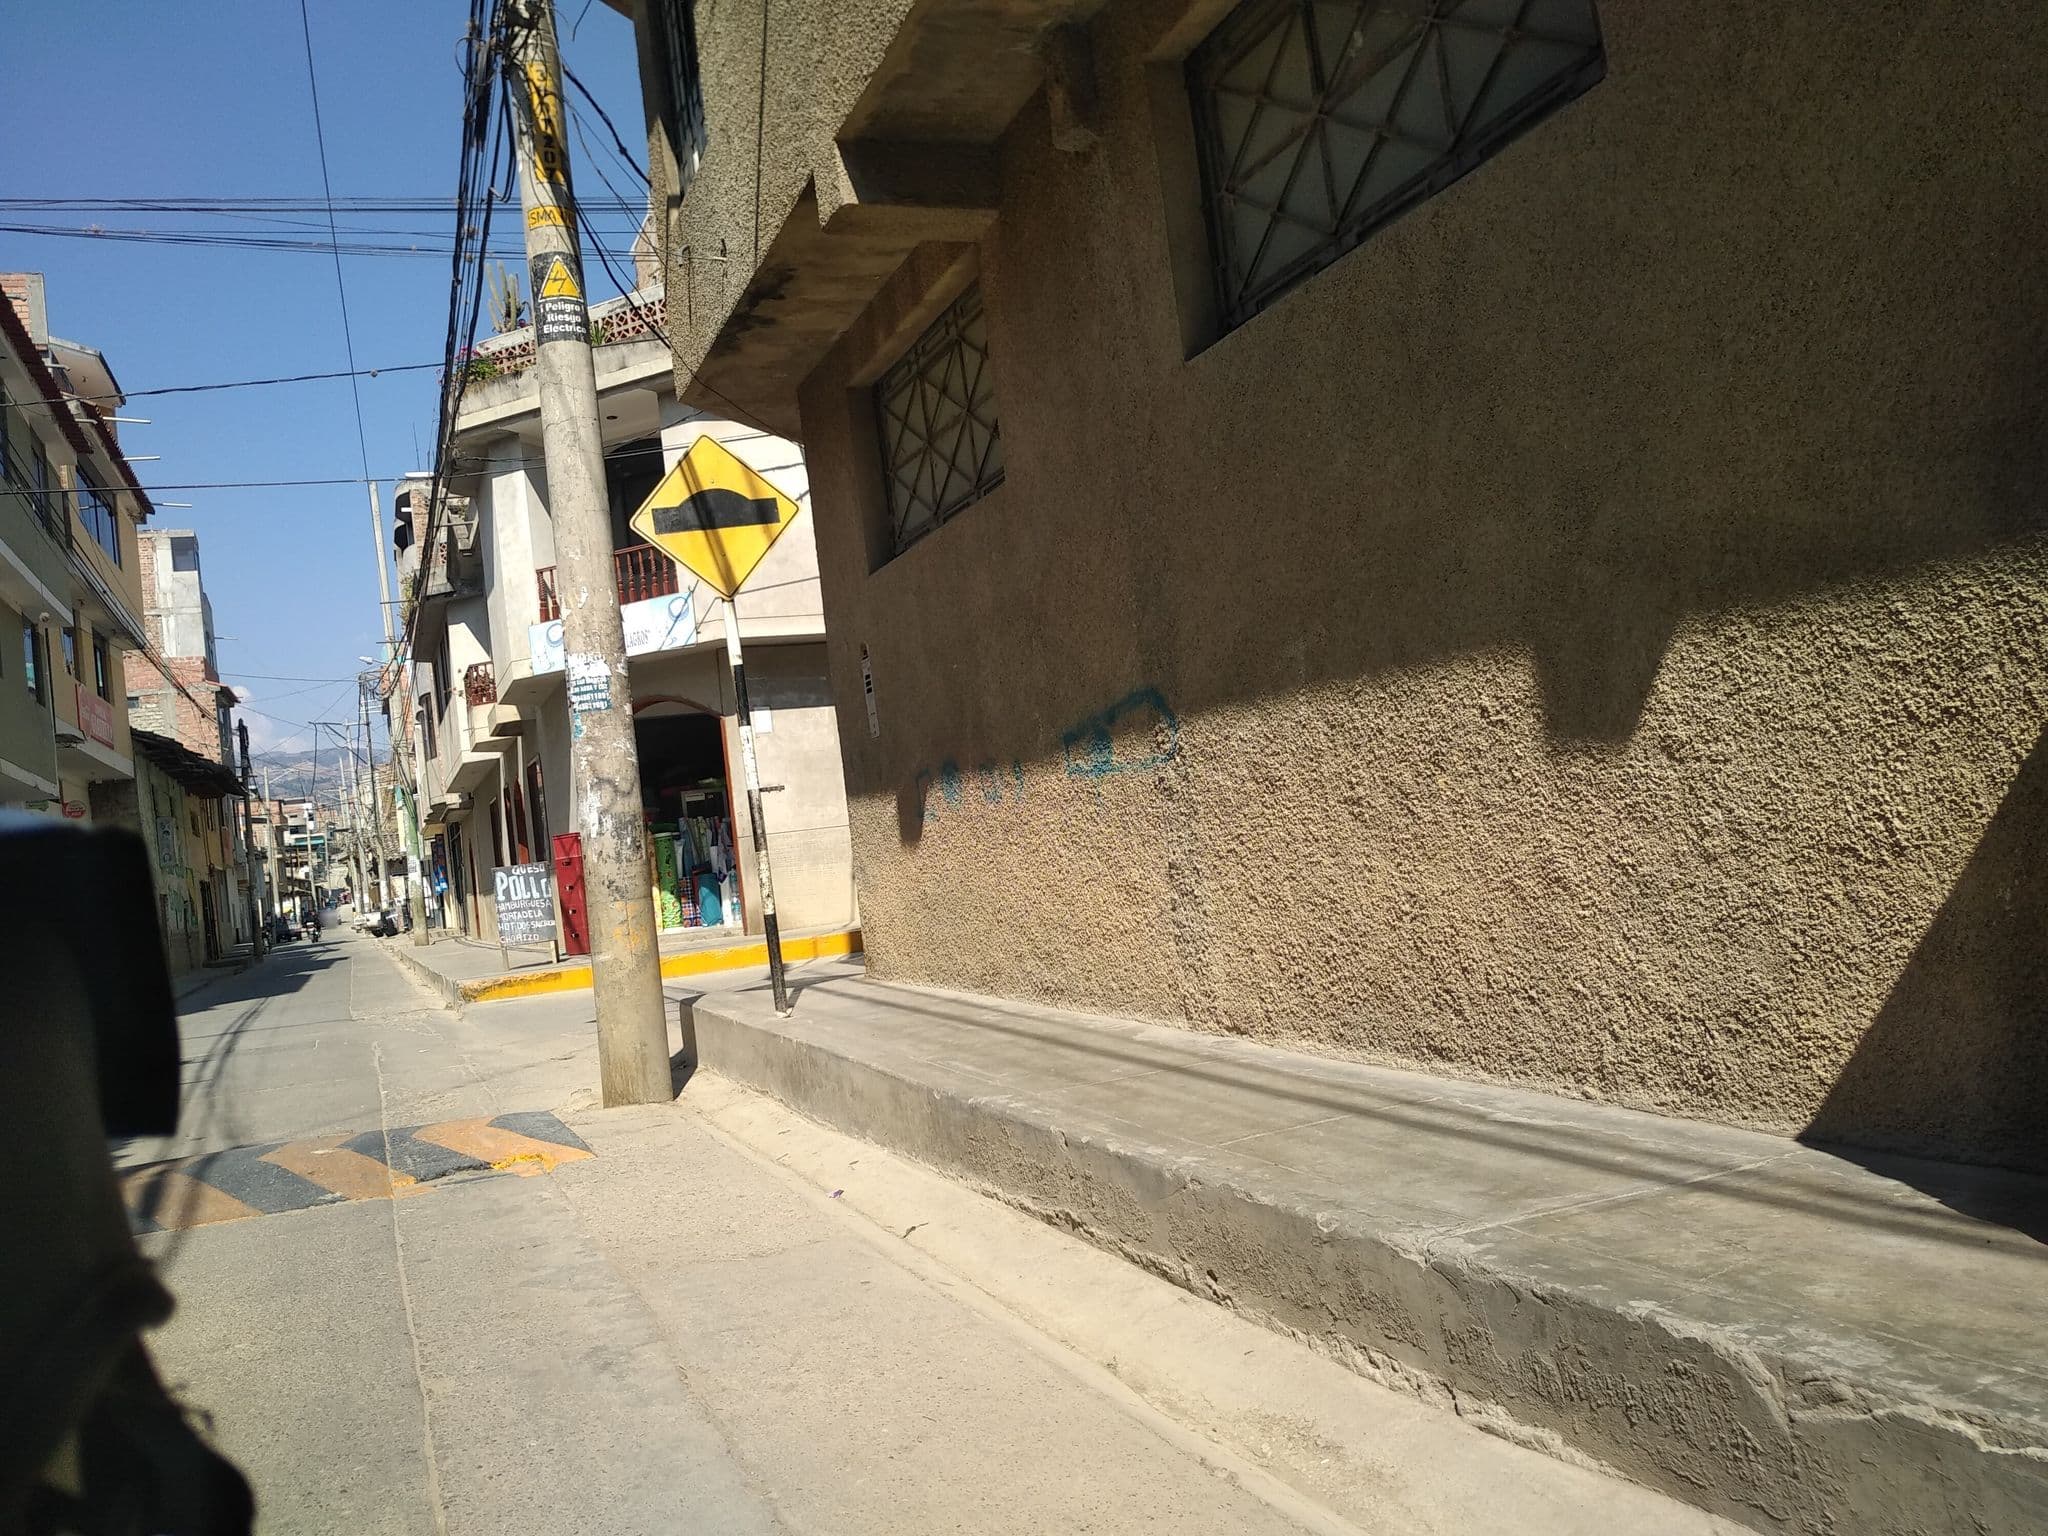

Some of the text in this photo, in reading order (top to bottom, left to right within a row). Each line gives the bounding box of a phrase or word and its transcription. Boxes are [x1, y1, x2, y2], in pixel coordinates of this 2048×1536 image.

[547, 313, 581, 323] Riesgo
[512, 864, 545, 875] QUESO
[496, 872, 552, 901] POLLO
[496, 900, 552, 911] HAMBURGUESA
[500, 935, 539, 943] CHORIZO
